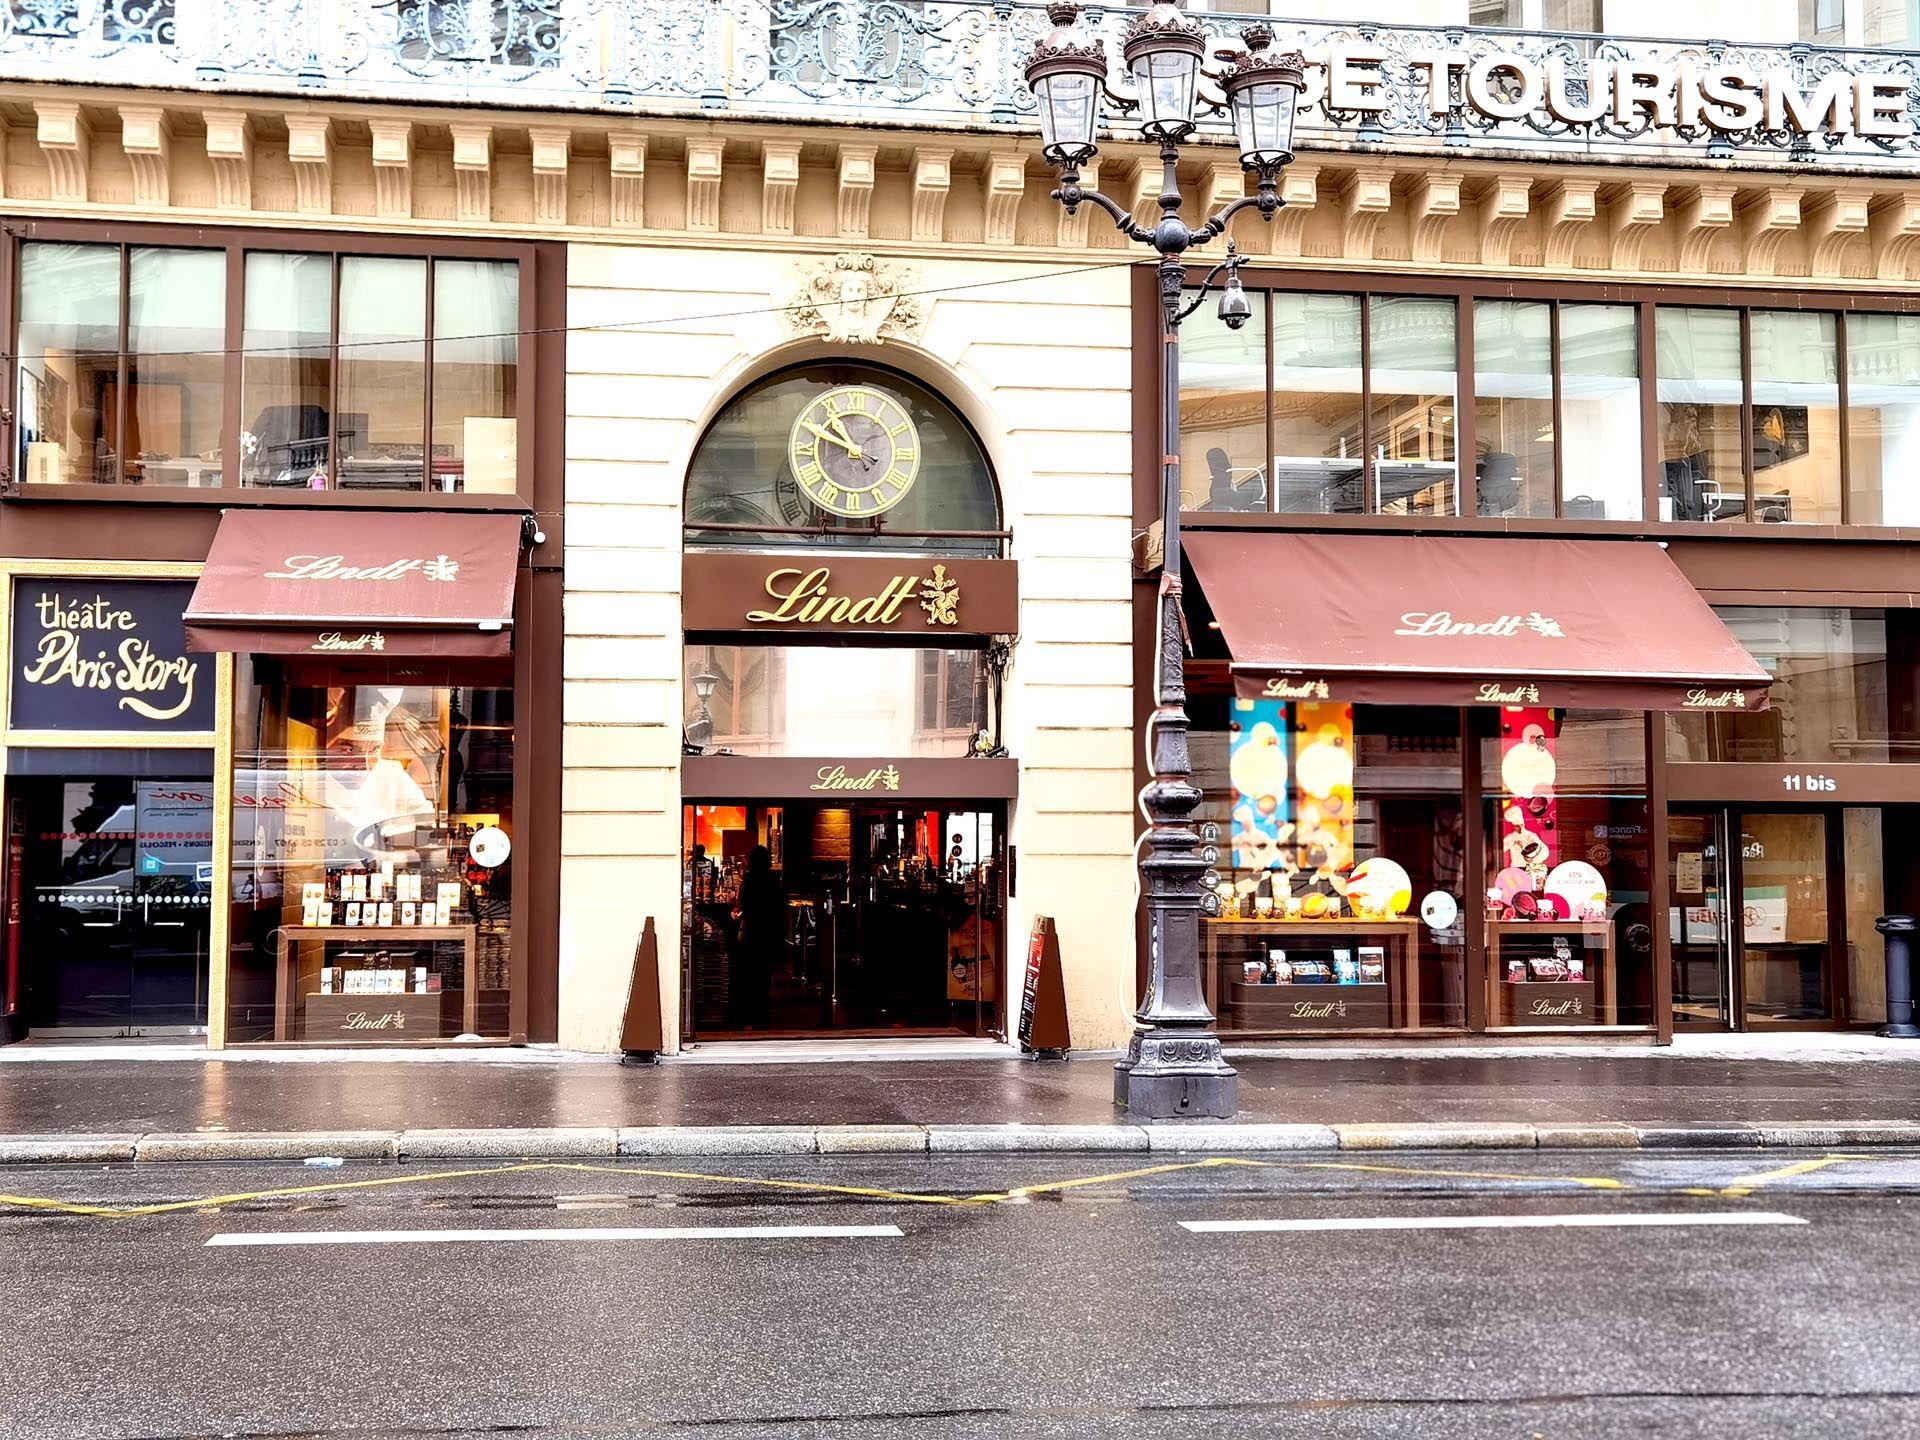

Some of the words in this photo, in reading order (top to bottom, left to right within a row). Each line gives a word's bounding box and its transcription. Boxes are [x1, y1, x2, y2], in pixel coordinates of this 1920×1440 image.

[1411, 52, 1914, 139] TOURISME
[263, 555, 424, 582] Lindt
[746, 567, 916, 624] Lindt
[35, 592, 138, 631] théâtre
[1394, 611, 1526, 637] Lindt
[311, 632, 372, 651] Lindt
[116, 638, 198, 720] Story
[1262, 678, 1315, 698] Lindt
[1475, 684, 1526, 703] Lindt
[1682, 689, 1738, 708] Lindt
[809, 766, 882, 791] Lindt
[1783, 776, 1802, 791] 11
[1807, 775, 1836, 792] bis
[1289, 1002, 1335, 1019] Lindt
[1528, 999, 1572, 1016] Lindt
[341, 1012, 391, 1030] Lindt
